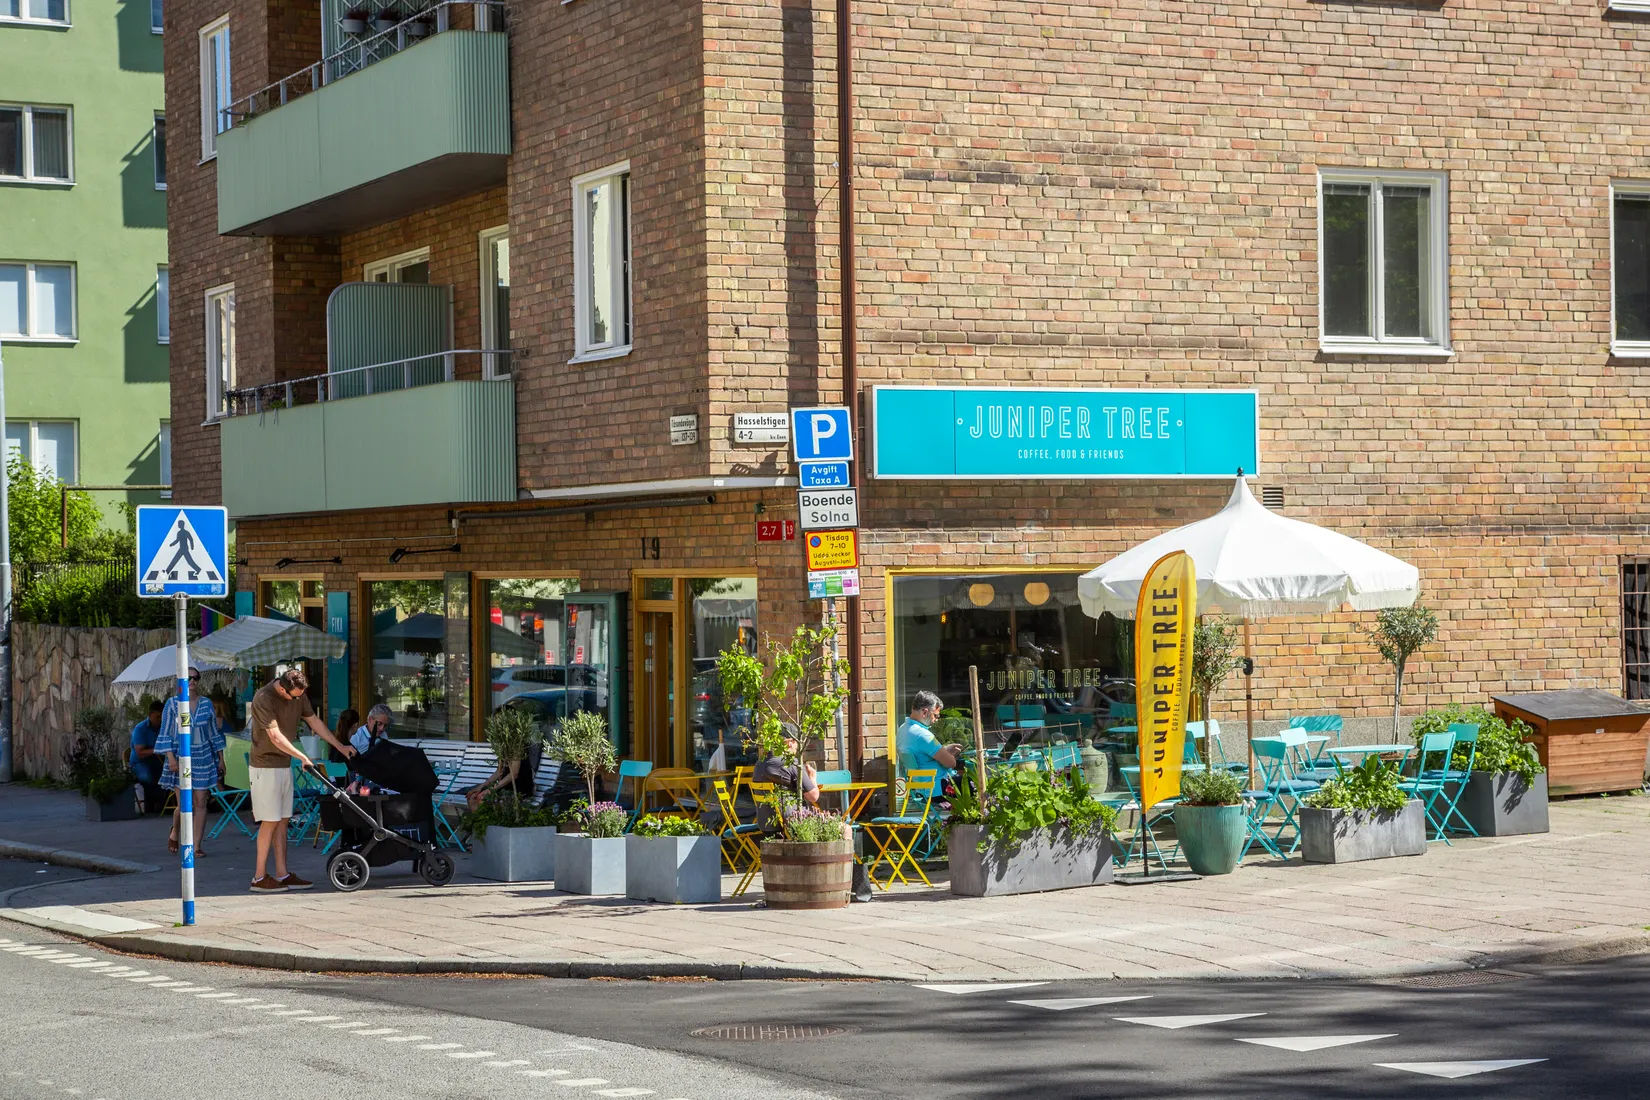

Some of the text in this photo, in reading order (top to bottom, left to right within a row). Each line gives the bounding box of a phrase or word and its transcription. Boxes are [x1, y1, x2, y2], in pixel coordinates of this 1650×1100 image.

[737, 416, 786, 428] Hasselstigen
[969, 405, 1171, 439] JUNIPER TREE
[738, 430, 753, 440] 4-2
[810, 413, 837, 455] P
[1017, 449, 1125, 460] COFFEE, FOOD & FRIENDS
[811, 465, 838, 476] Avgift
[810, 475, 841, 485] Taxa A
[802, 494, 854, 507] Boende
[811, 510, 850, 523] Solna
[761, 525, 777, 537] 2,7
[641, 536, 660, 560] 19
[986, 667, 1101, 691] JUNIPER TREE
[1153, 587, 1178, 778] JUNIPER TREE
[1175, 677, 1183, 696] FOOD
